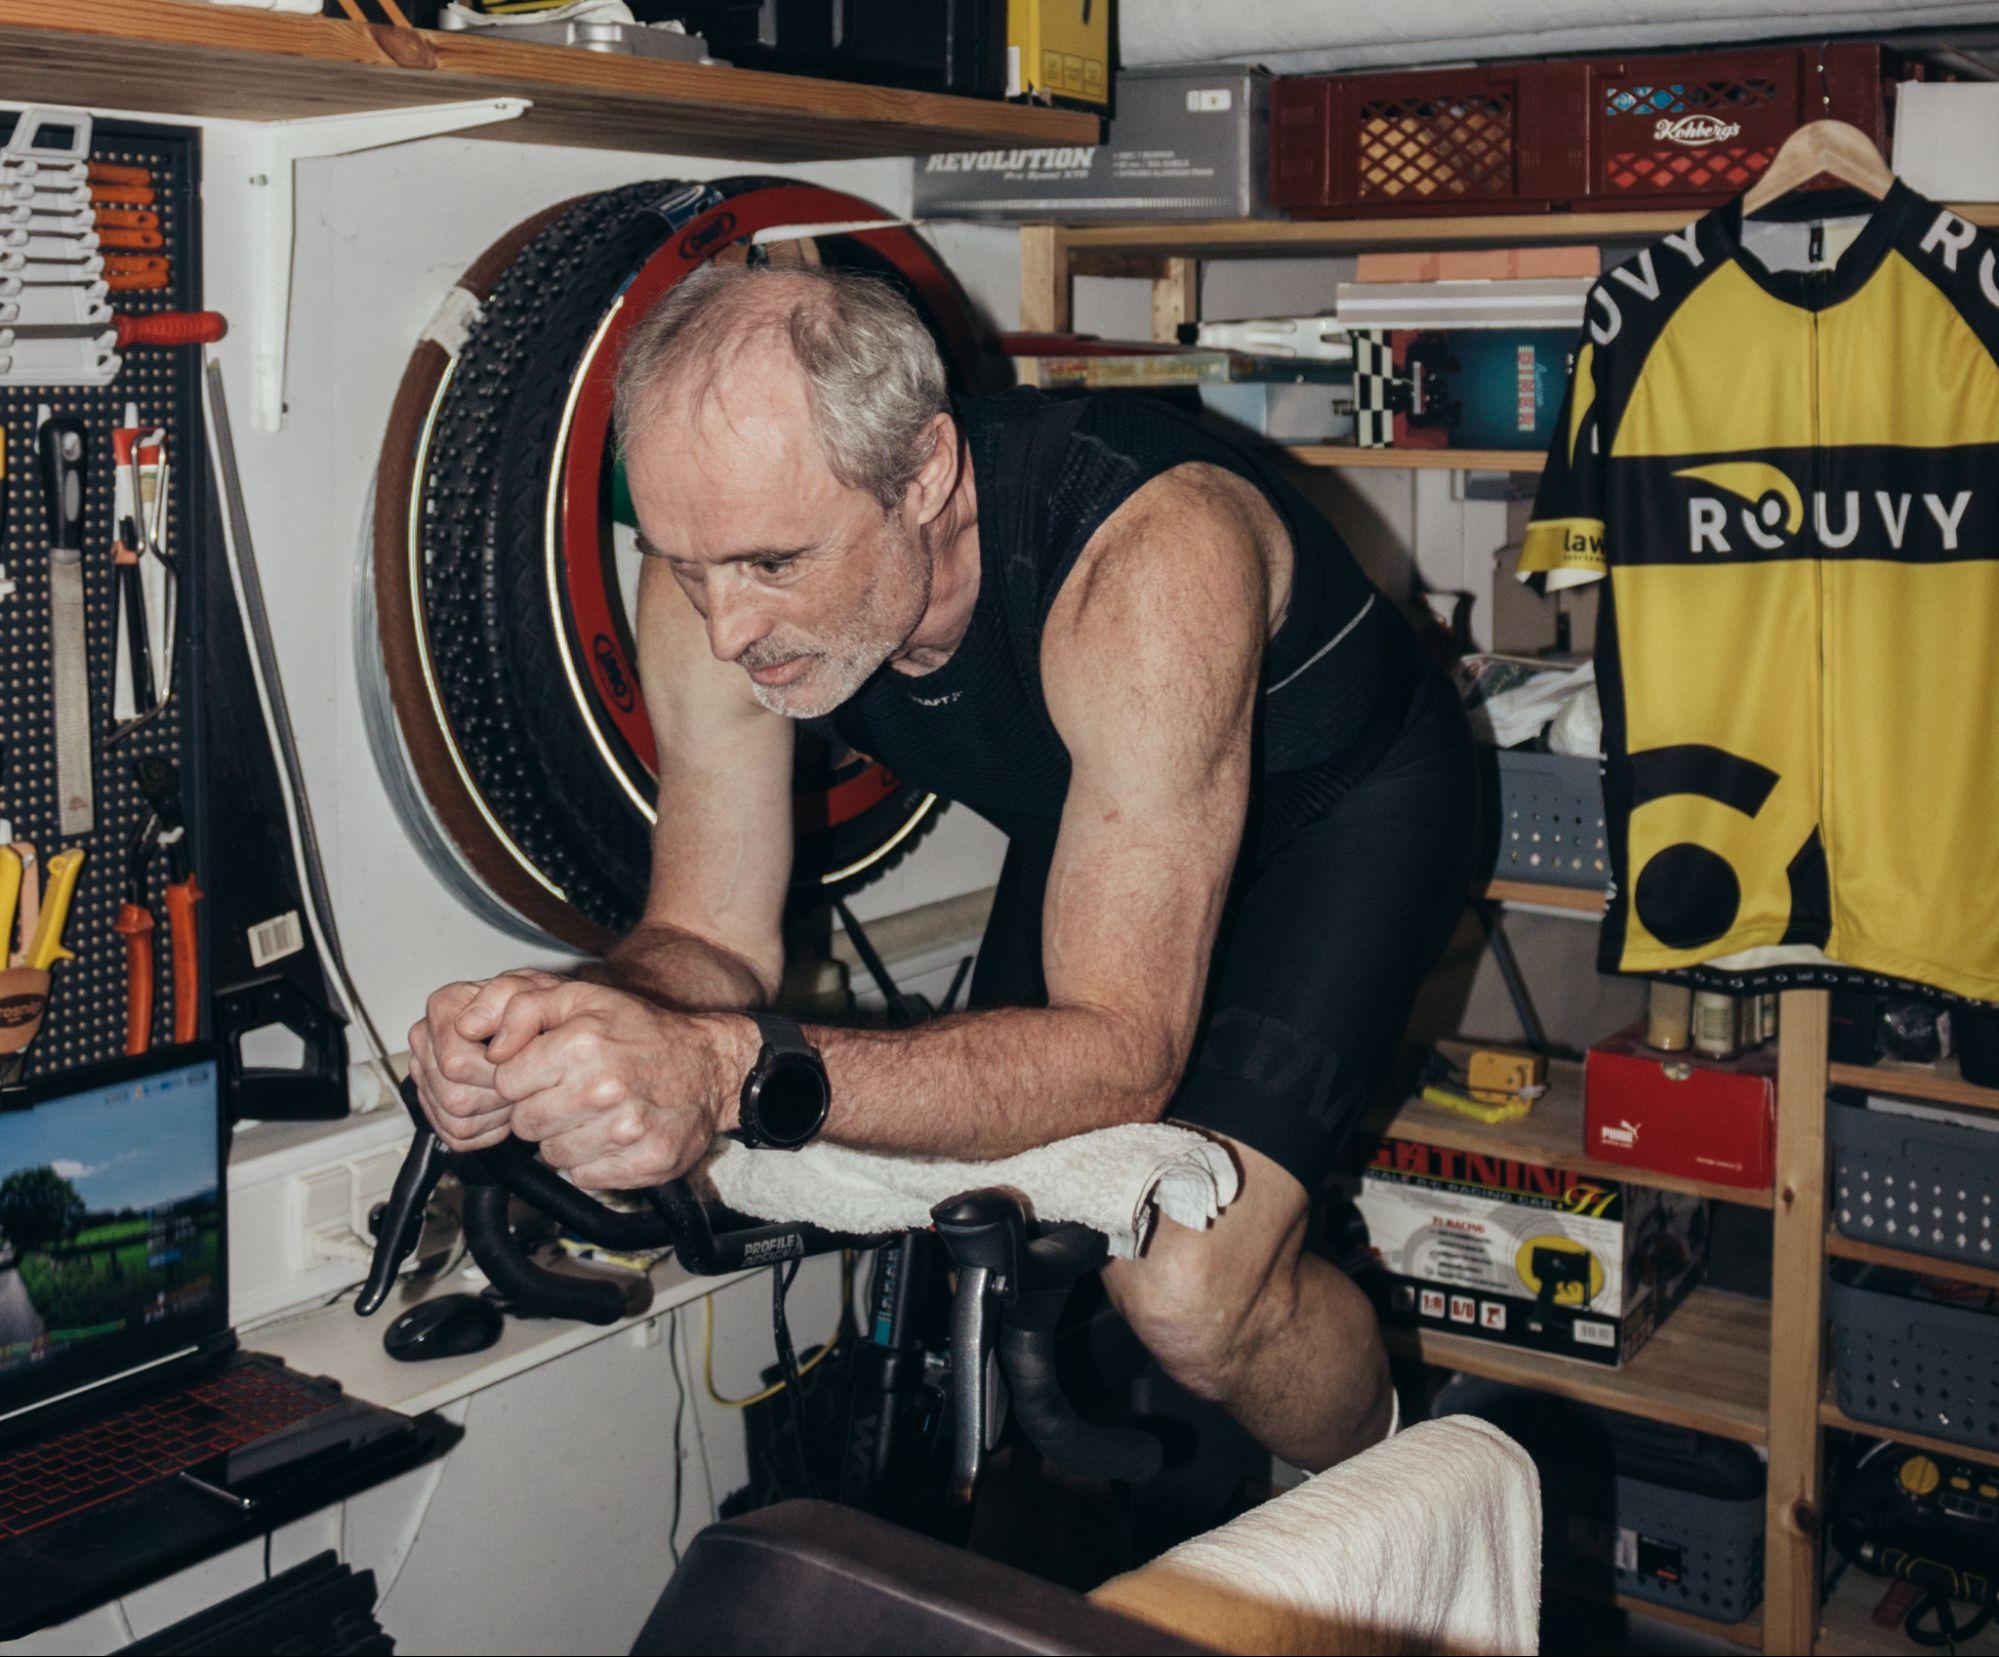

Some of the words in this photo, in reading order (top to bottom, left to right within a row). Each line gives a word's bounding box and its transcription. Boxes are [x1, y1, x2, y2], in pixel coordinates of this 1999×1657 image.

[925, 147, 1096, 172] REVOLUTION
[1689, 489, 1973, 554] ROUVY
[1602, 1126, 1633, 1143] PUMA
[744, 1234, 796, 1257] PROFILE
